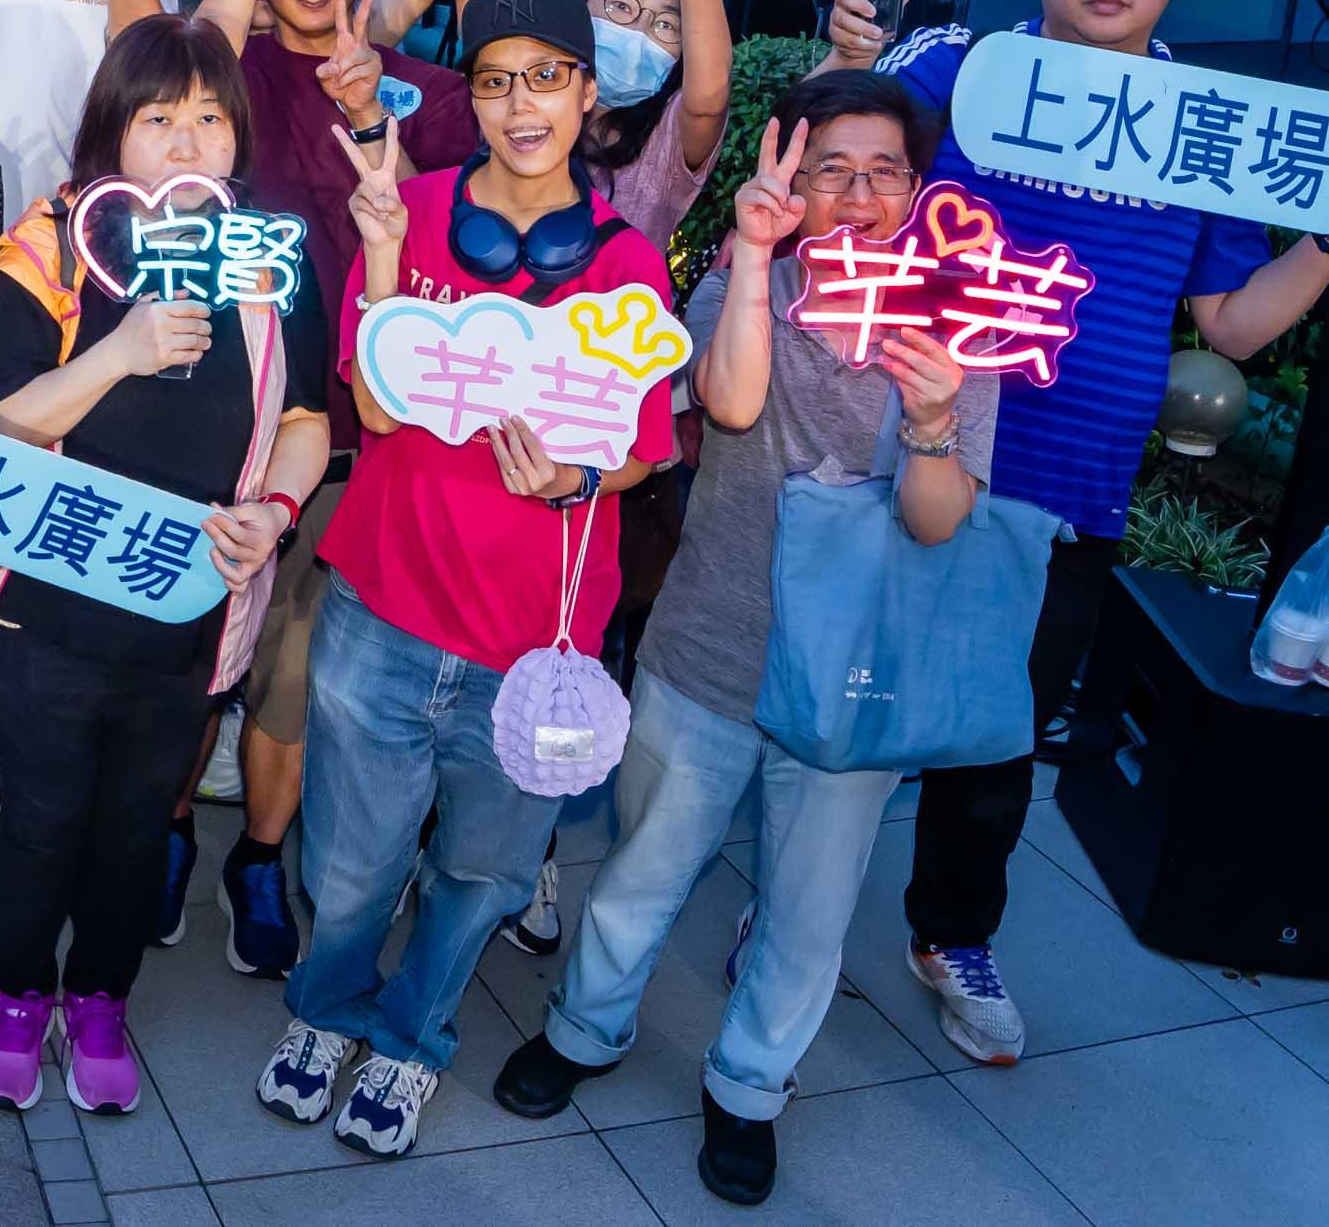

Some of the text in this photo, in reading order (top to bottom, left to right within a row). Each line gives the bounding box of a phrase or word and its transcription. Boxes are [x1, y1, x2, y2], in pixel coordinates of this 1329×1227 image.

[991, 58, 1329, 210] 上水廣場
[127, 205, 303, 311] 宗賢
